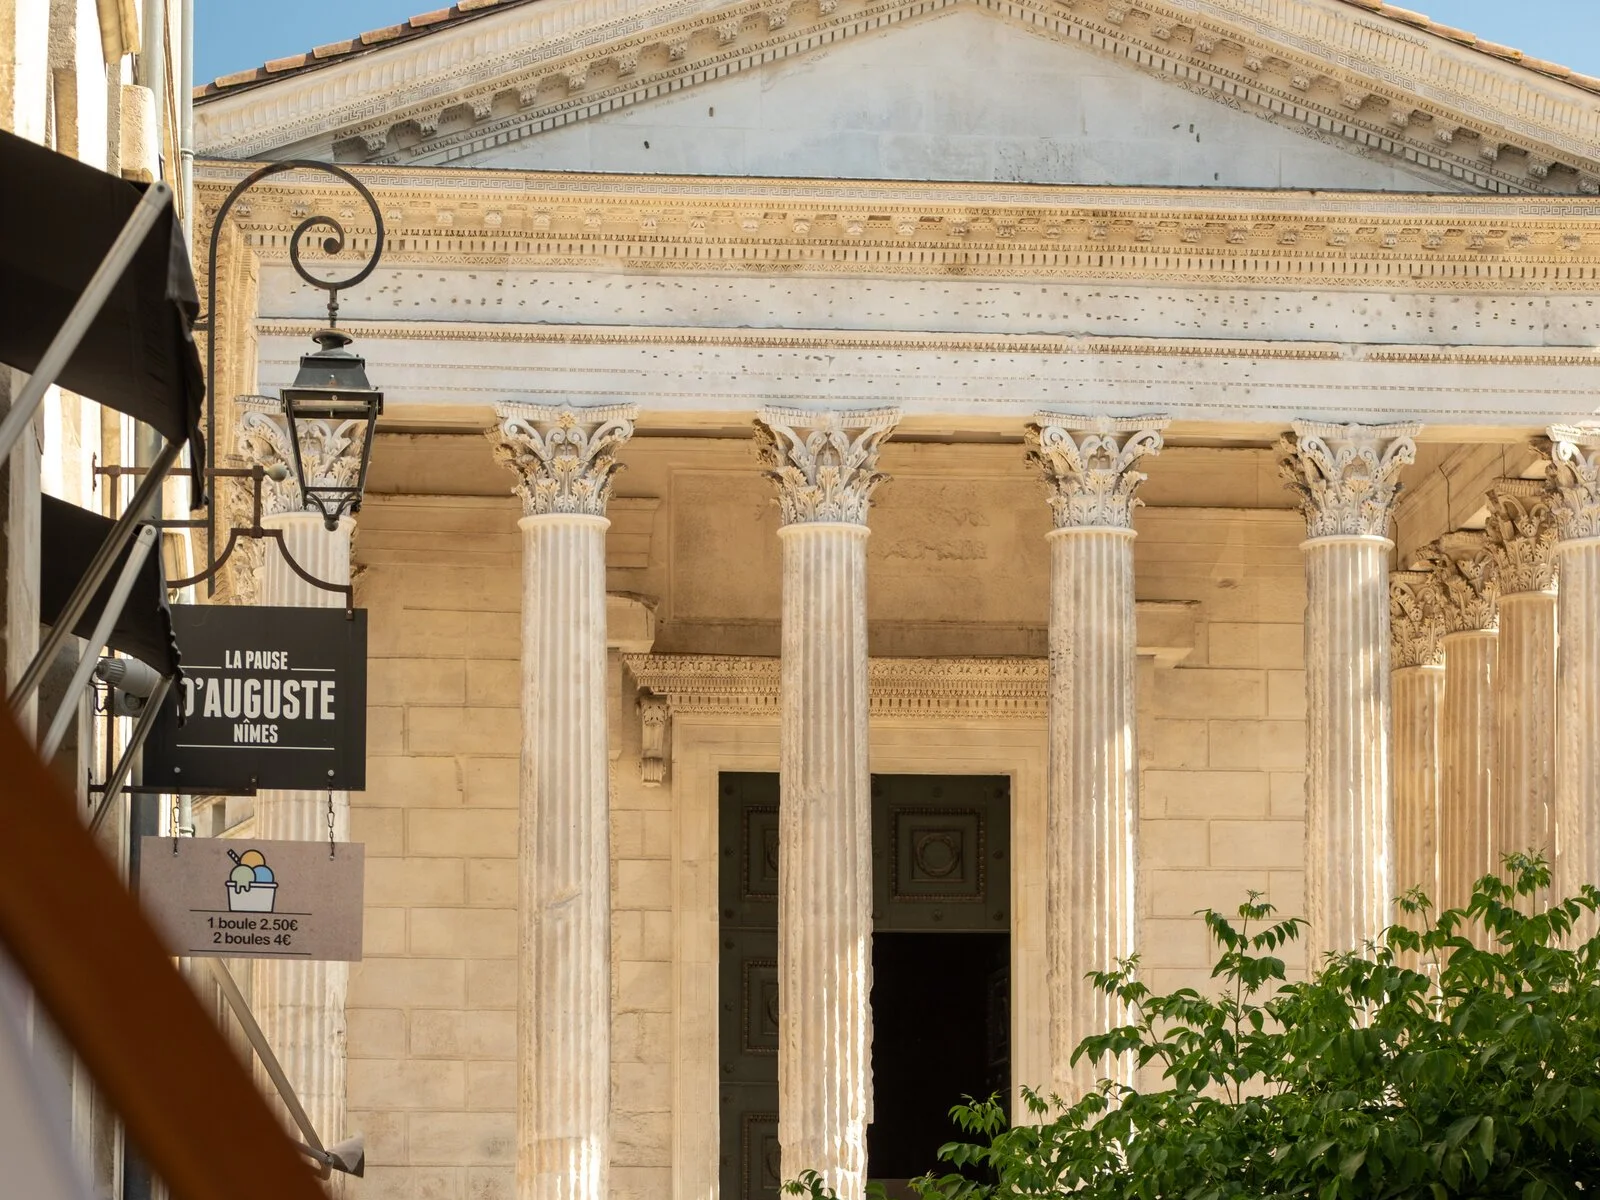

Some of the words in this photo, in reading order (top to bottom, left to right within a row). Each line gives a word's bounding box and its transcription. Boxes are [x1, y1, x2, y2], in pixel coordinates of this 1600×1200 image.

[225, 650, 242, 669] LA
[245, 651, 288, 670] PAUSE
[233, 718, 279, 744] NÎMES
[207, 916, 214, 929] 1
[218, 917, 257, 930] boule
[259, 918, 298, 931] 2.50€
[213, 932, 222, 944] 2
[224, 932, 271, 946] boules
[273, 934, 292, 946] 4€
